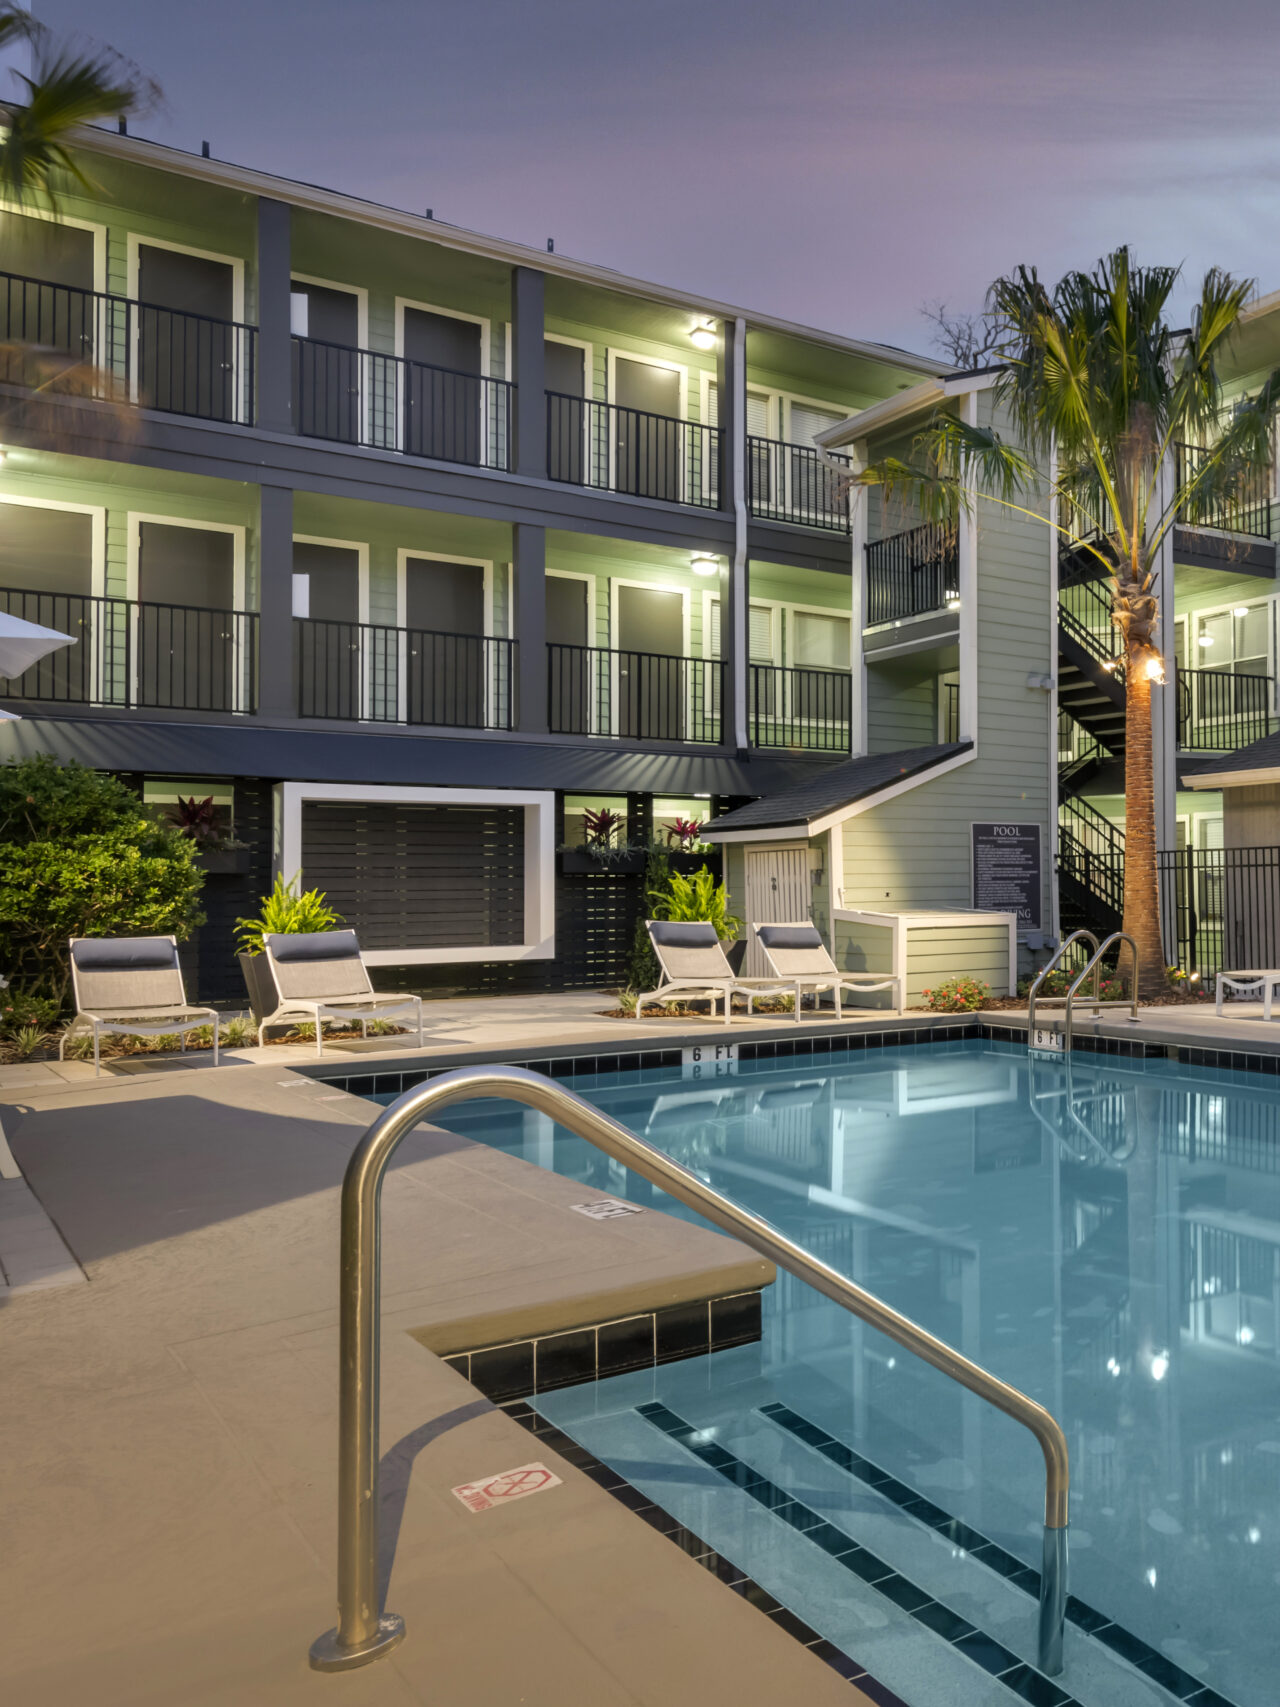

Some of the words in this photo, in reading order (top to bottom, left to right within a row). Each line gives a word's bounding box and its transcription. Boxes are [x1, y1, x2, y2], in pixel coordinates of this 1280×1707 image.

[994, 826, 1020, 836] POOL
[1037, 1031, 1043, 1043] 6
[692, 1047, 702, 1062] 6
[715, 1044, 733, 1060] FT.
